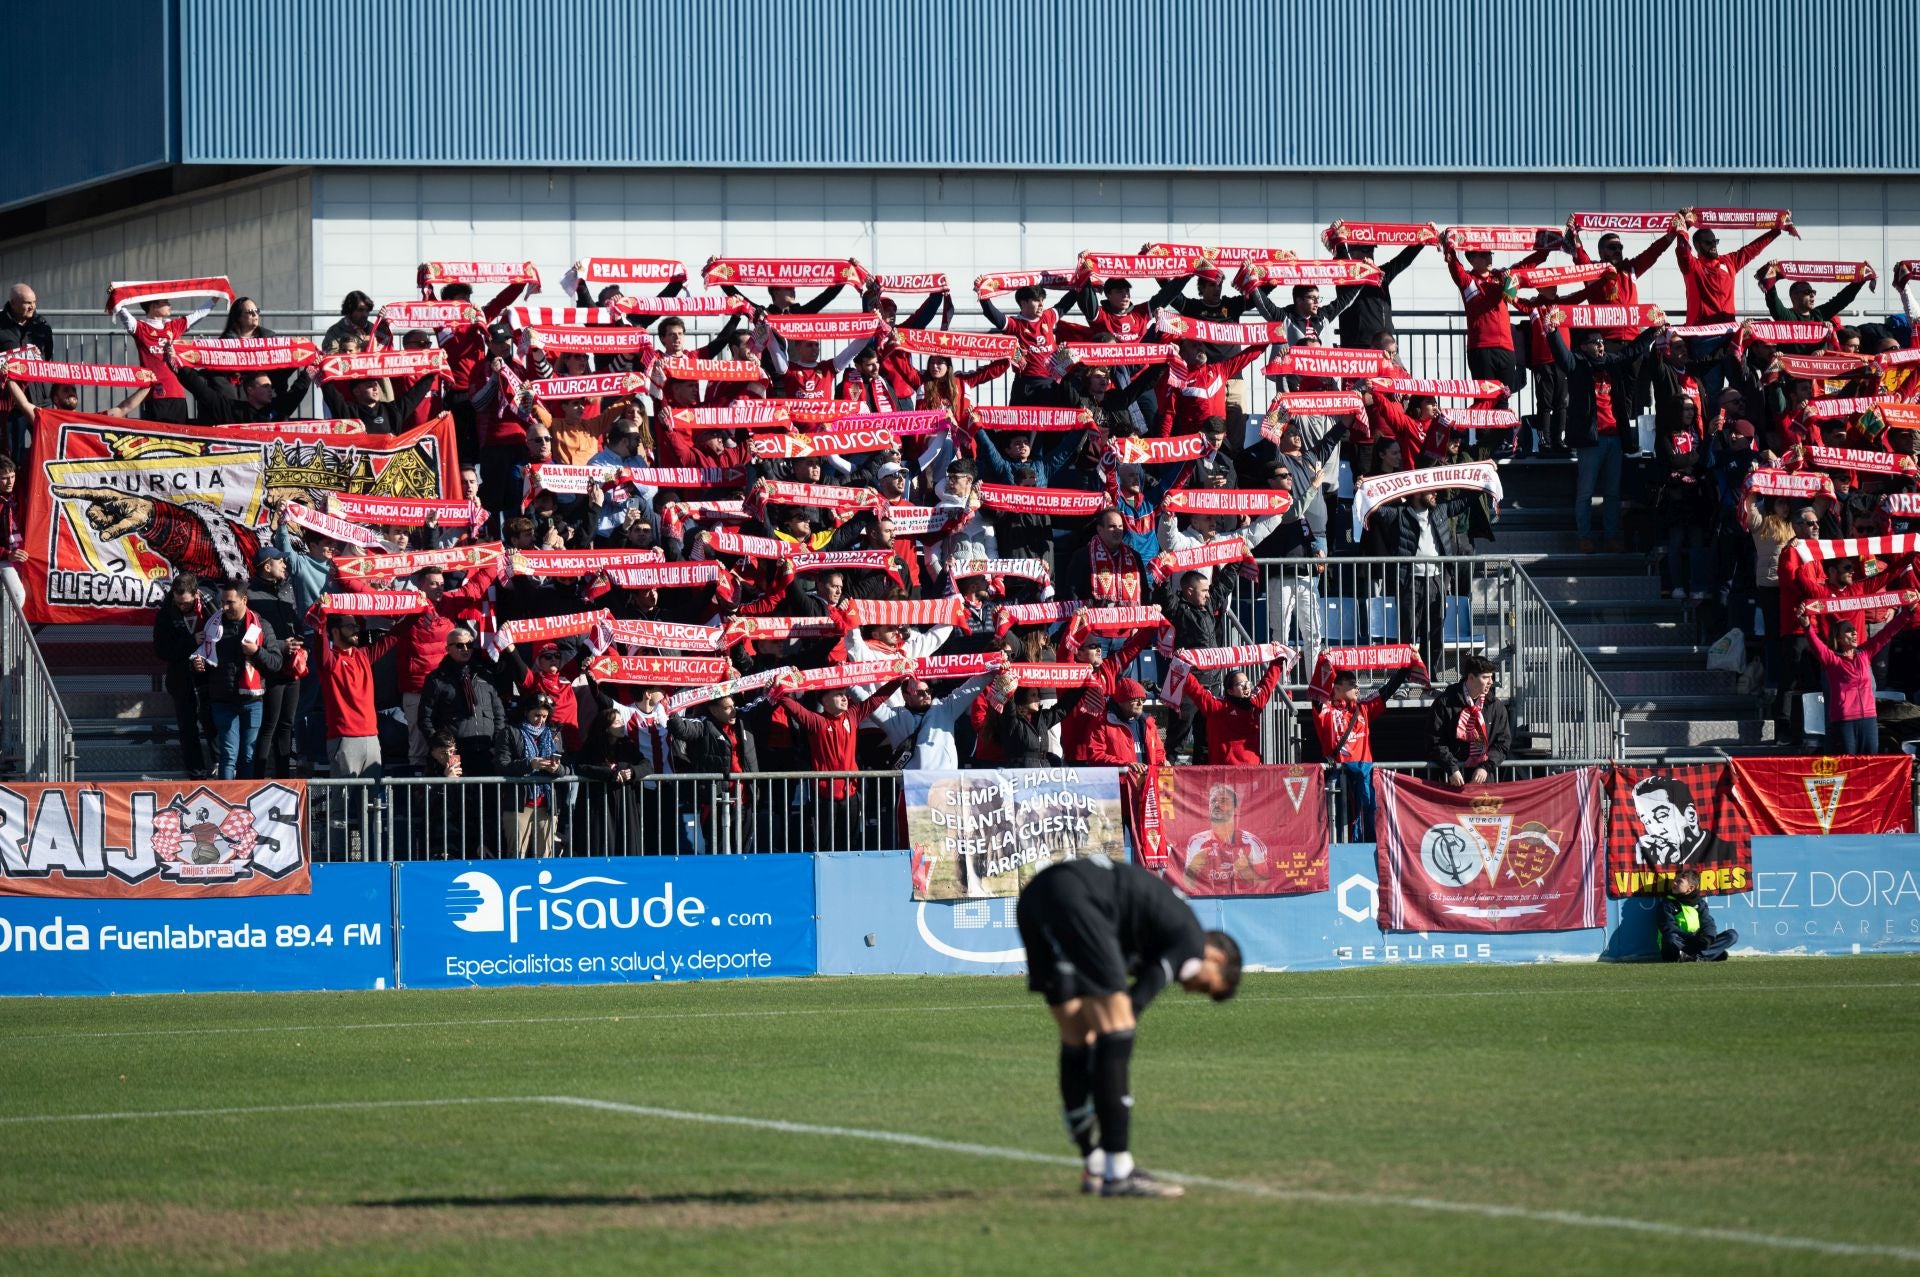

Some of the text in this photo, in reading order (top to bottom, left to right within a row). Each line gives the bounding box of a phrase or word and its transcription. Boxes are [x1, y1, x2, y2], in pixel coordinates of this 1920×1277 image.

[1583, 214, 1643, 229] MURCIA
[1352, 228, 1416, 243] real murcia
[1173, 247, 1269, 260] REAL MURCIA
[443, 262, 524, 276] REAL MURCIA
[738, 264, 835, 278] REAL MURCIA
[1097, 256, 1187, 271] REAL MURCIA
[1267, 265, 1347, 279] REAL MURCIA
[1003, 277, 1030, 288] Real
[638, 296, 727, 312] COMO UNA SOLA ALMA
[1572, 307, 1640, 327] REAL MURCIA CF
[560, 333, 592, 345] MURCIA
[594, 333, 615, 345] CLUB
[616, 333, 625, 345] DE
[909, 329, 936, 345] REAL
[952, 332, 997, 349] MURCIA
[1751, 323, 1774, 339] COMO
[1775, 323, 1792, 339] UNA
[1793, 323, 1812, 340] SOLA
[1091, 345, 1155, 358] MURCIA CLUB DE
[349, 357, 382, 371] REAL
[384, 355, 429, 369] MURCIA
[1791, 360, 1811, 368] REAL
[1812, 361, 1840, 370] MURCIA
[548, 379, 598, 396] MURCIA
[601, 377, 621, 392] C.F.
[1393, 378, 1481, 395] COMO UNA SOLA ALMA
[1291, 397, 1341, 410] MURCIA CLUB DE
[694, 408, 775, 425] COMO UNA SOLA ALMA
[979, 410, 990, 424] TU
[1019, 409, 1029, 424] ES
[1029, 409, 1038, 424] LA
[1038, 409, 1052, 425] QUE
[1053, 410, 1077, 425] CANTA
[814, 428, 891, 450] murcia
[1812, 446, 1895, 465] REAL MURCIA
[100, 470, 225, 493] MURCIA
[632, 467, 723, 483] COMO UNA SOLA ALMA
[1414, 472, 1430, 485] DE
[1432, 467, 1482, 483] MURCIA
[776, 483, 854, 500] REAL MURCIA
[980, 492, 1103, 508] REAL MURCIA CLUB DE FÚTBO
[342, 502, 363, 515] REAL
[364, 504, 399, 517] MURCIA
[400, 506, 423, 518] CLUB
[1188, 493, 1196, 508] TU
[1220, 494, 1229, 508] ES
[1229, 494, 1237, 509] LA
[1238, 494, 1249, 510] QUE
[1250, 494, 1269, 510] CANTA
[529, 555, 622, 569] REAL MURCIA CLUB DE
[50, 571, 144, 603] LLEGAN
[633, 571, 660, 589] MURCIA
[660, 570, 679, 589] CLUB
[680, 569, 692, 587] DE
[332, 594, 417, 614] COMO UNA SOLA ALMA
[510, 612, 594, 634] REAL MURCIA
[804, 667, 837, 680] REAL
[842, 660, 893, 678] MURCIA
[1022, 668, 1079, 681] MURCIA CLUB DE
[946, 767, 1080, 807] SIEMPRE HACIA
[931, 790, 1099, 834] DELANTE AUNQUE
[1468, 816, 1503, 825] MURCIA
[945, 815, 1090, 856] PESE LA CUESTA
[987, 843, 1052, 878] ARRIBA
[1724, 918, 1920, 937] UTOCARES
[99, 922, 267, 951] Fuenlabrada
[277, 923, 333, 947] 89.4
[344, 923, 382, 946] FM
[1339, 943, 1491, 961] SEGUROS
[446, 952, 572, 977] Especialistas
[578, 957, 605, 972] en
[669, 955, 684, 974] y
[688, 948, 772, 971] deporte
